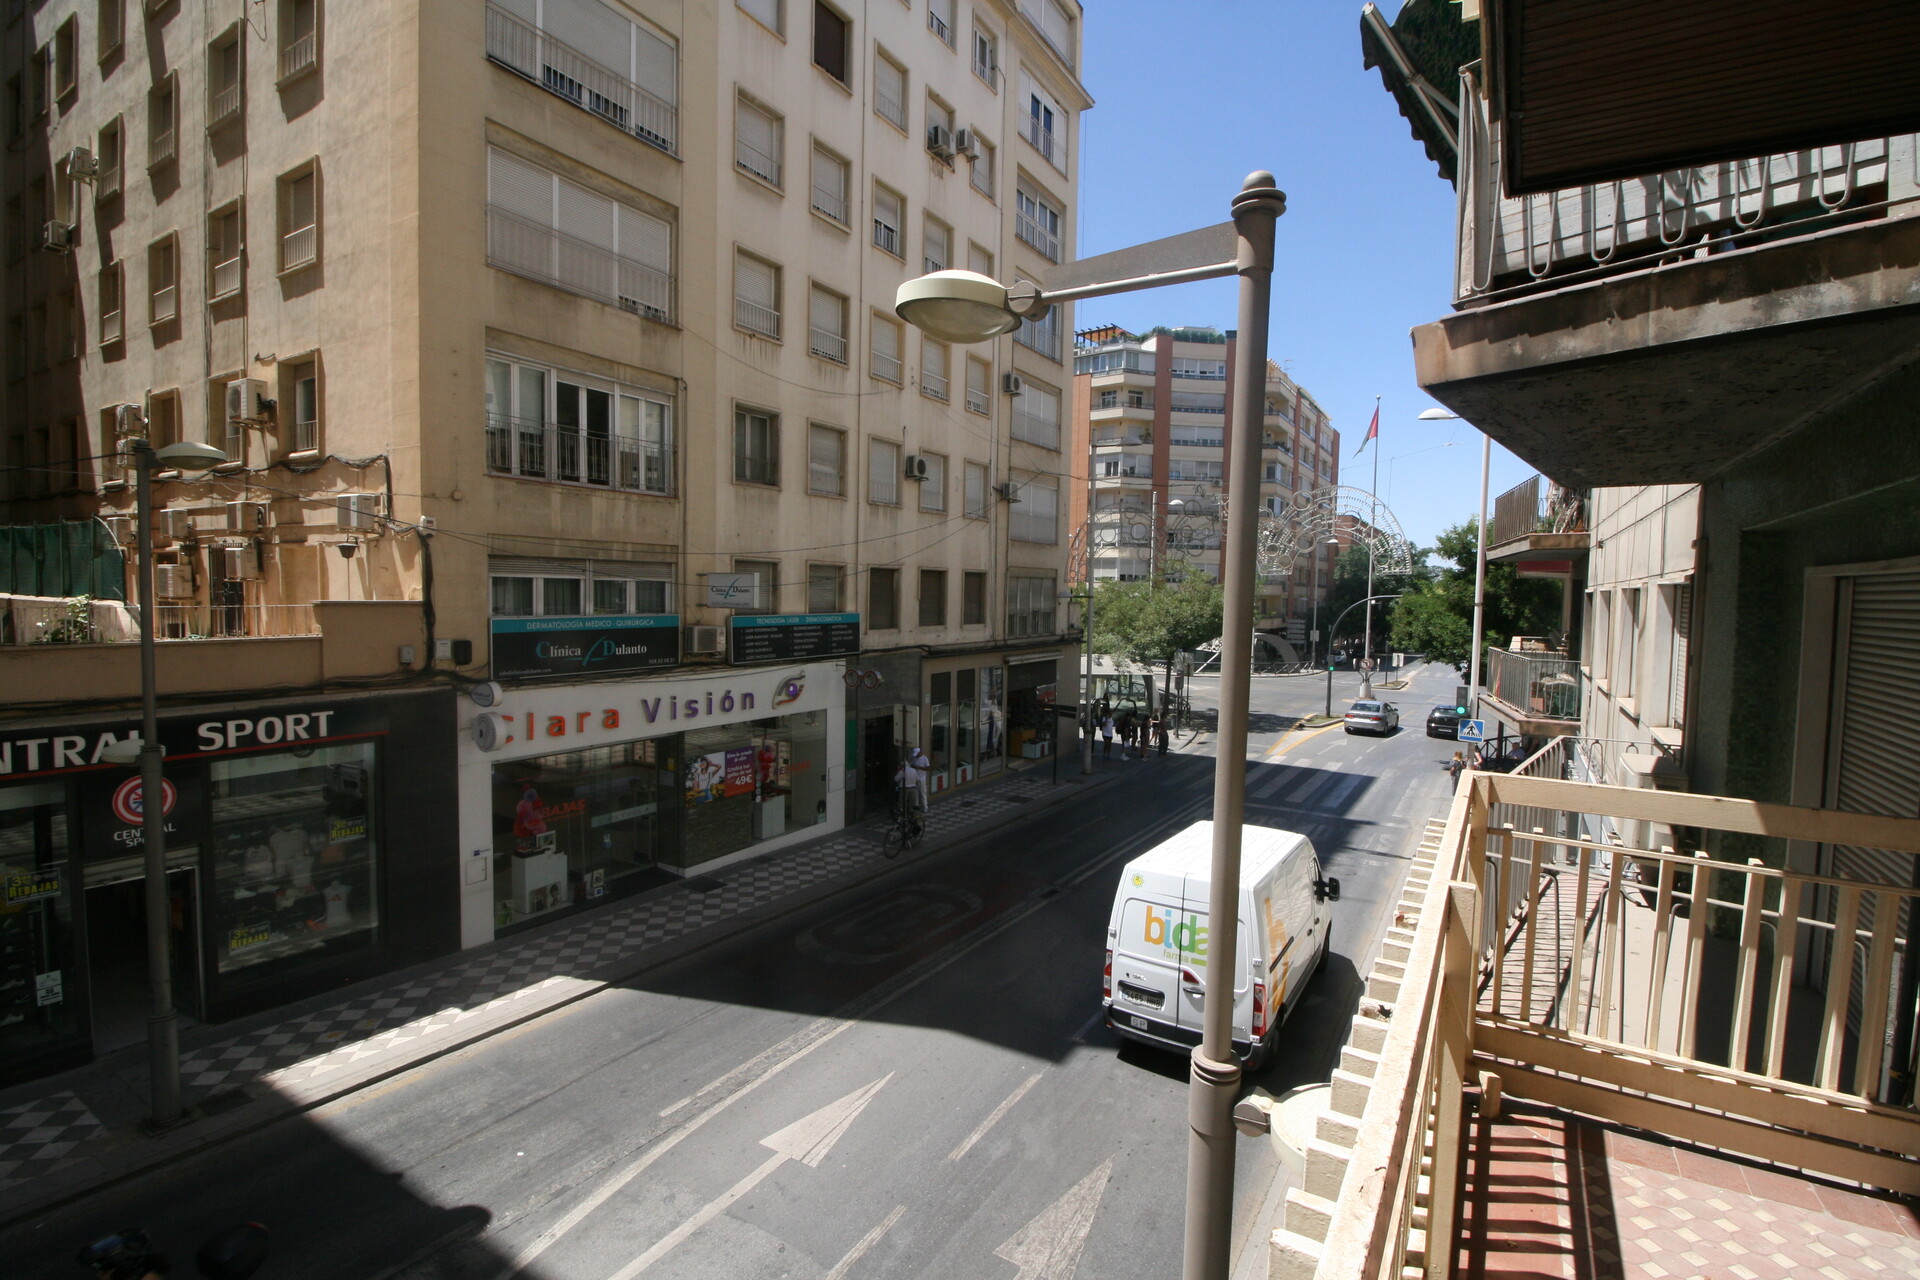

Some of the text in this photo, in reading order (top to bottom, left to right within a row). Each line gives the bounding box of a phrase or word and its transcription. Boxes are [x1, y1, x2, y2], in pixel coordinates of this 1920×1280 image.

[526, 619, 583, 630] DERMATOLOGÍA
[535, 639, 648, 659] Clínica Dulanto
[640, 688, 756, 724] Visión
[196, 710, 335, 752] SPORT
[735, 774, 753, 786] 49€
[9, 880, 59, 898] REBAJAS
[1144, 904, 1209, 956] bida
[1132, 1018, 1146, 1027] SP
